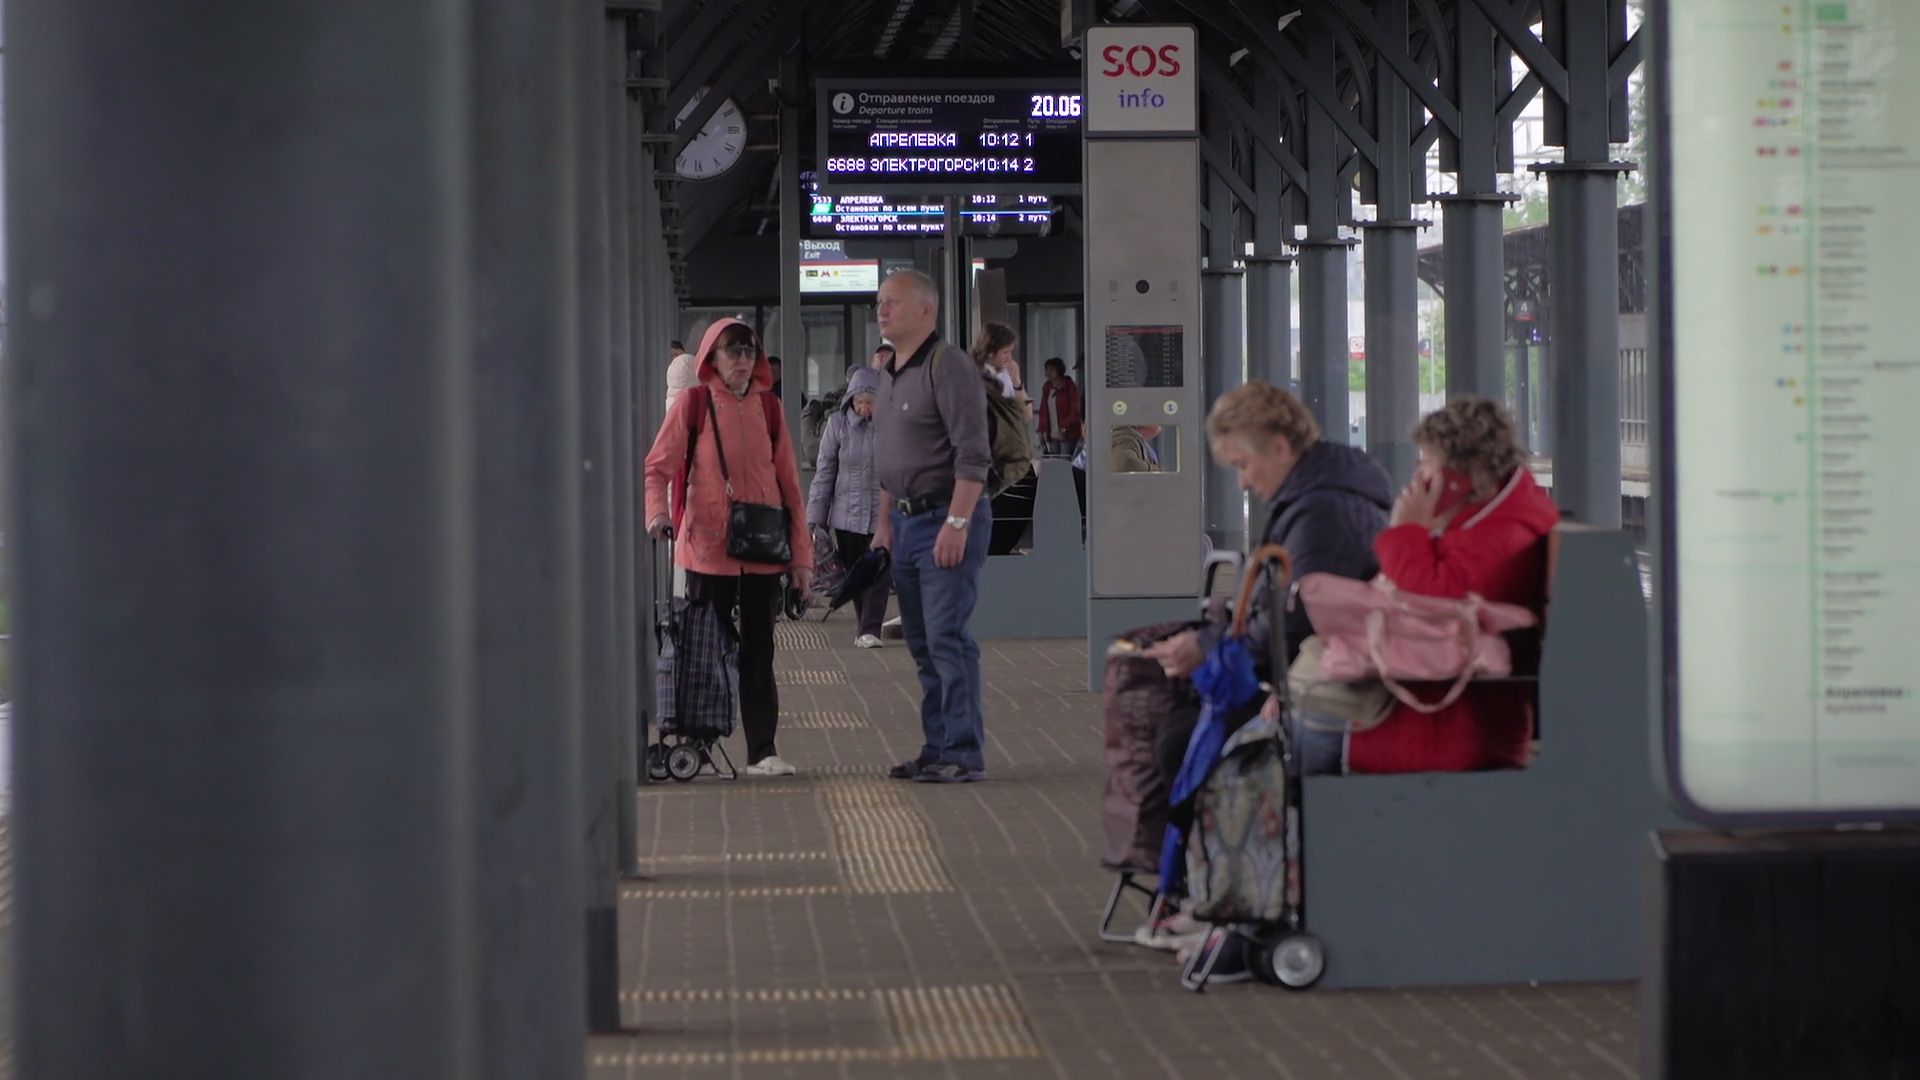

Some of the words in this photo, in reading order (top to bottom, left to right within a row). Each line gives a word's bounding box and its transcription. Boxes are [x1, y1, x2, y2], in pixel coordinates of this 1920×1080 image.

[1102, 45, 1181, 77] SOS
[858, 92, 941, 105] Отправление
[944, 94, 996, 105] поездов
[1118, 88, 1165, 108] info
[858, 105, 905, 116] Departure
[907, 106, 934, 114] trains
[1031, 95, 1081, 117] 20.06
[869, 133, 956, 147] АПРЕЛЕВКА
[979, 133, 1019, 147] 10:12
[1025, 133, 1033, 147] 1
[827, 158, 866, 172] 6688
[979, 158, 1019, 172] 10:14
[1023, 158, 1034, 172] 2
[839, 195, 884, 204] АПРЕЛЕВКА
[972, 195, 996, 204] 10:12
[1019, 195, 1024, 203] 1
[1027, 196, 1048, 204] путь
[835, 205, 879, 213] Остановки
[840, 215, 898, 223] ЭЛЕКТРОГОРСК
[972, 214, 996, 223] 10:14
[1019, 214, 1024, 222] 2
[1027, 215, 1048, 223] путь
[835, 224, 879, 232] Остановки
[803, 240, 841, 252] Выход
[803, 251, 820, 260] Exit
